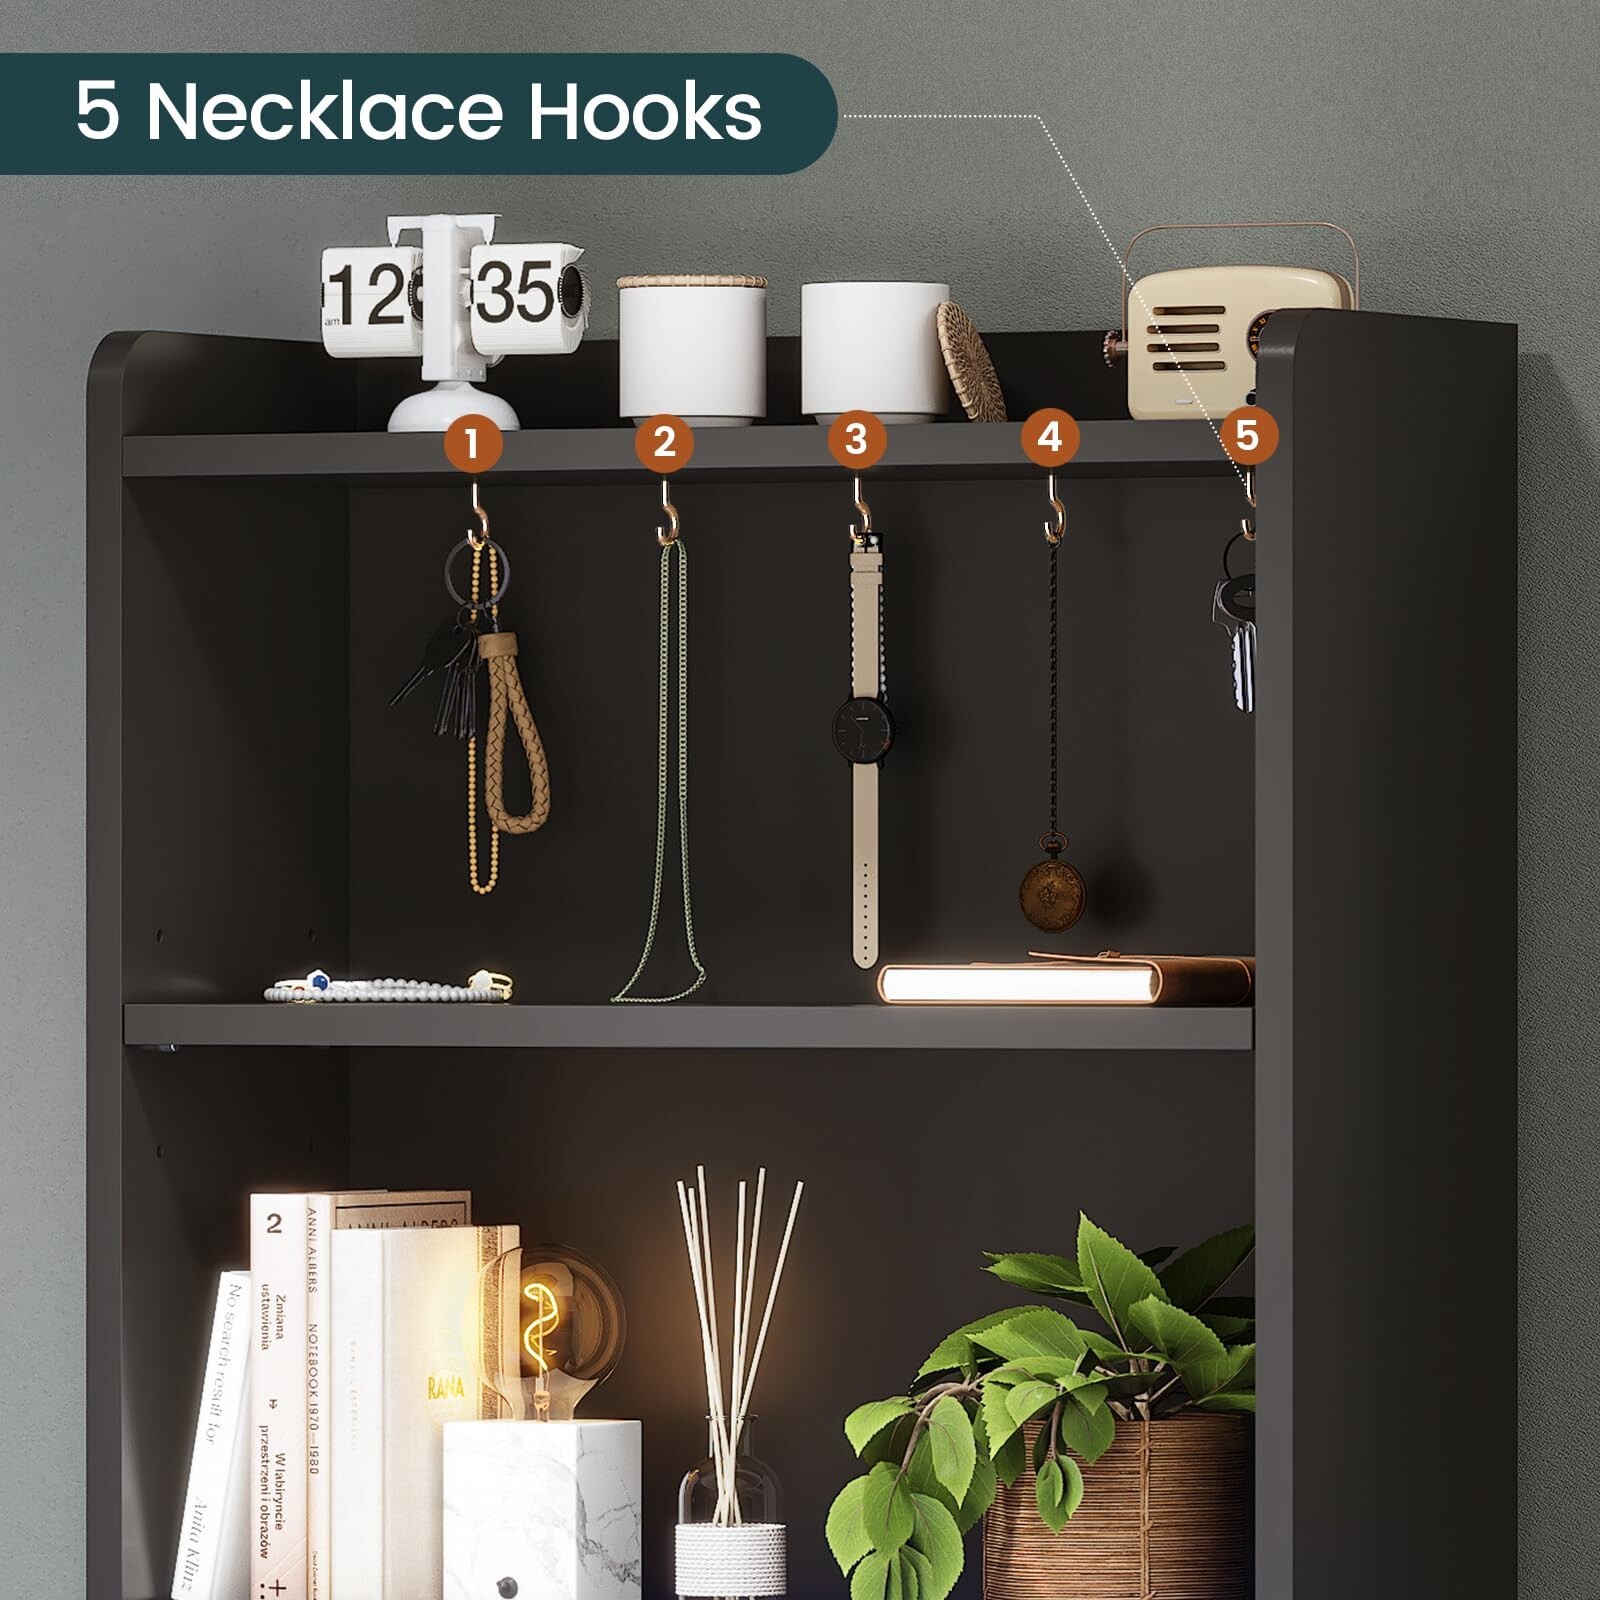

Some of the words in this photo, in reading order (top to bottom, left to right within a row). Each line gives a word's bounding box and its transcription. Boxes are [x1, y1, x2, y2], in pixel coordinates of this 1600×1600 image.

[328, 262, 405, 326] 12
[476, 260, 555, 324] 35
[324, 317, 341, 327] am
[266, 1213, 282, 1234] 2
[307, 1207, 317, 1241] ANNI
[308, 1246, 318, 1293] ALBERS
[226, 1283, 242, 1308] No
[260, 1283, 272, 1352] ustawienia
[275, 1294, 286, 1340] Zmiana
[218, 1312, 236, 1367] search
[308, 1323, 319, 1398] NOTEBOOK
[209, 1371, 225, 1417] result
[205, 1423, 221, 1446] for
[258, 1425, 271, 1495] przestrzeni
[275, 1452, 286, 1467] W
[272, 1469, 286, 1531] labiryncie
[259, 1504, 271, 1560] obrazów
